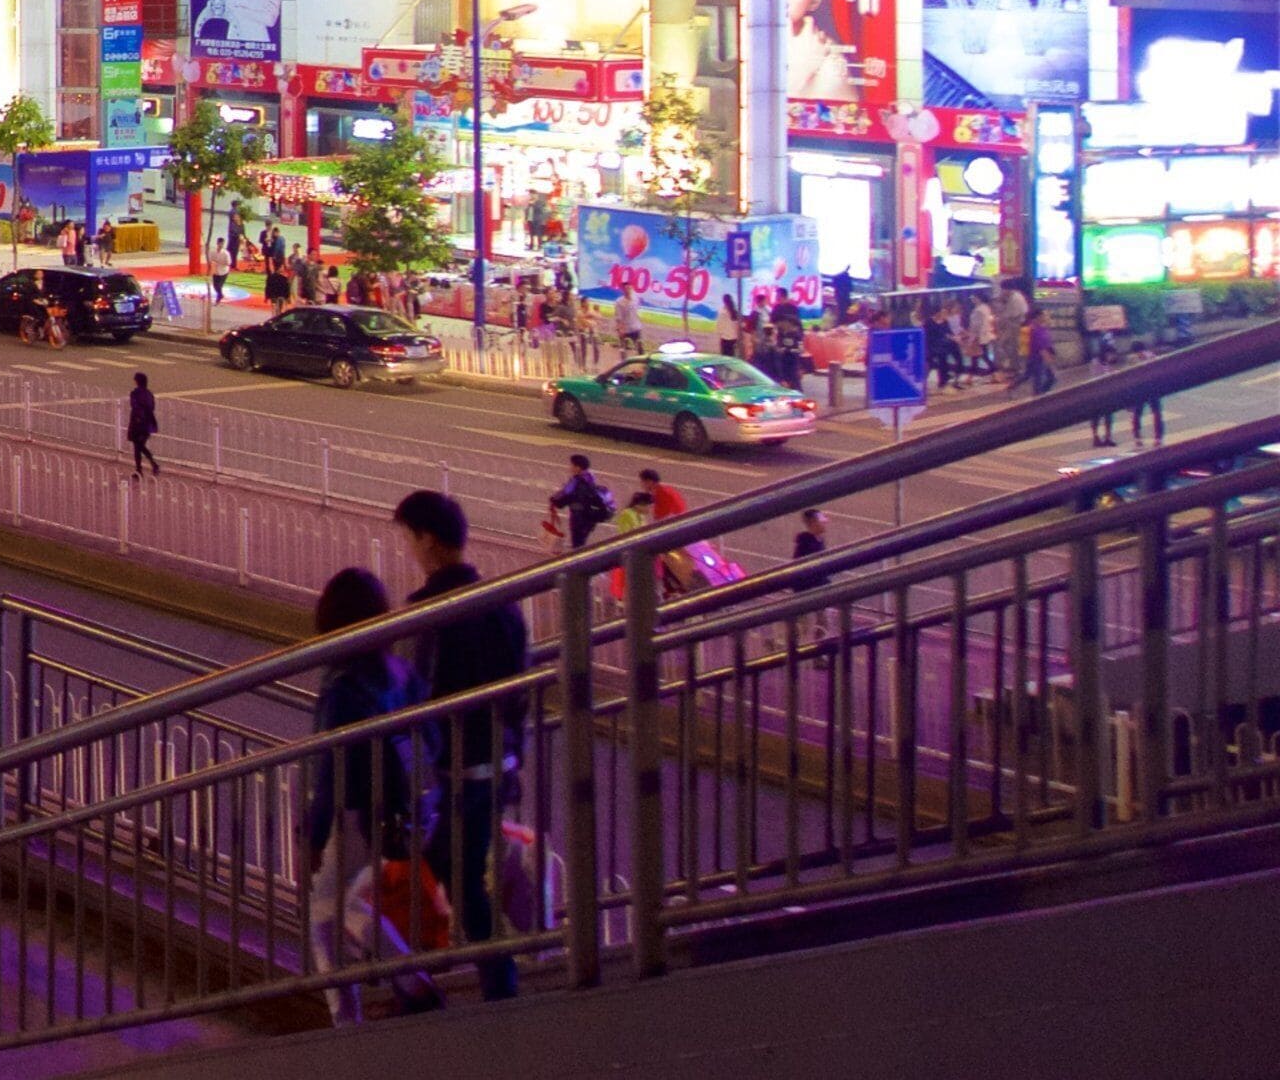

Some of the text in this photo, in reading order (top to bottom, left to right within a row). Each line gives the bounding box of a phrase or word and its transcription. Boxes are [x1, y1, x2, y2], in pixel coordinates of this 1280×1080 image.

[734, 238, 746, 262] P
[608, 264, 711, 301] 100 50
